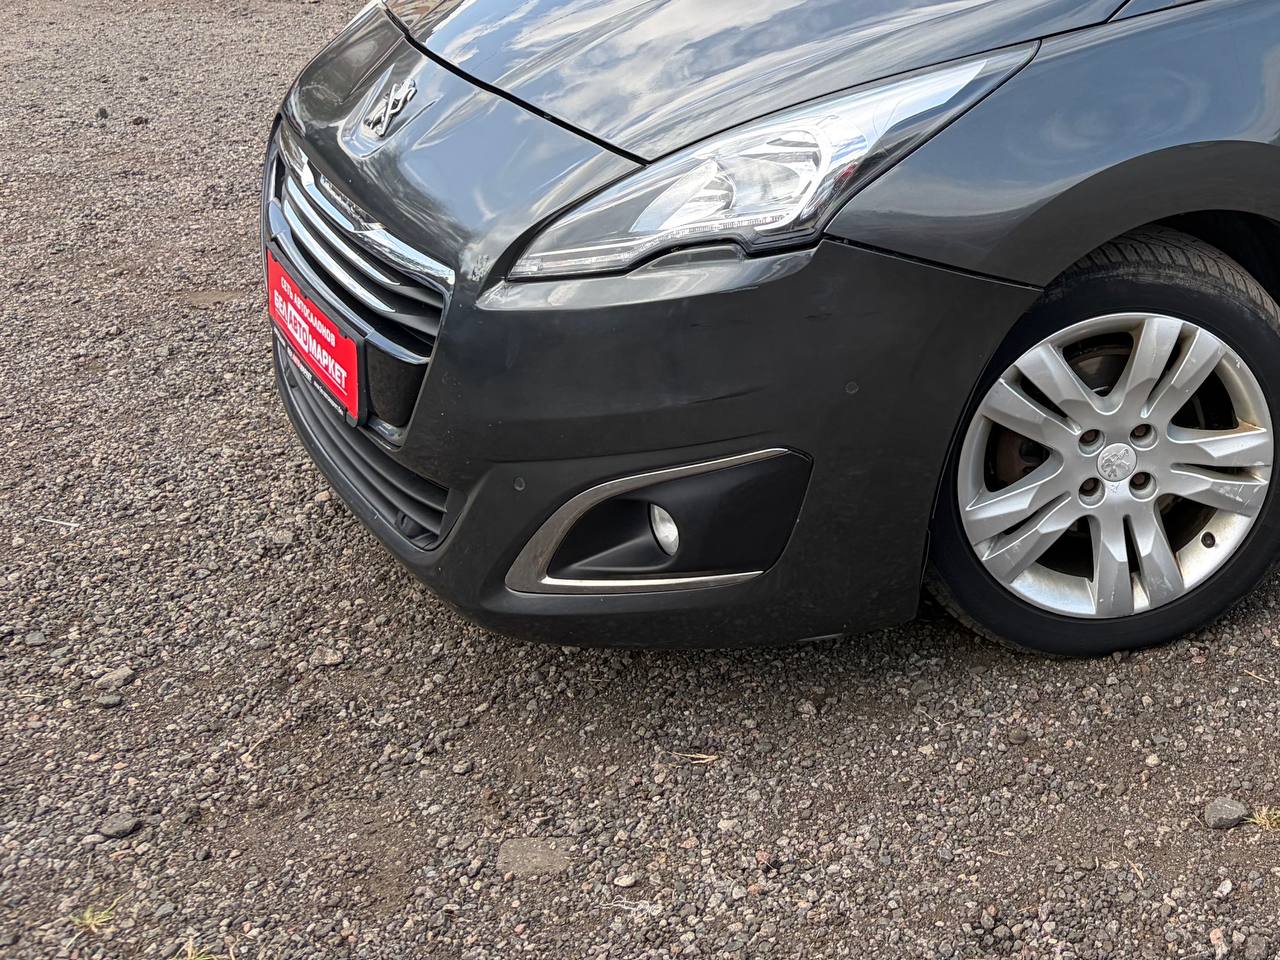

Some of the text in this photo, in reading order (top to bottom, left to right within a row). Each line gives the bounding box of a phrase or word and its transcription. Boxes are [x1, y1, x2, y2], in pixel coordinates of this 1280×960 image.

[274, 289, 288, 322] БЕЛ
[288, 304, 309, 352] АВТО
[308, 333, 348, 390] МАРКЕТ
[281, 276, 294, 300] СЕТЬ
[294, 292, 336, 348] АВТОСАЛОНОВ
